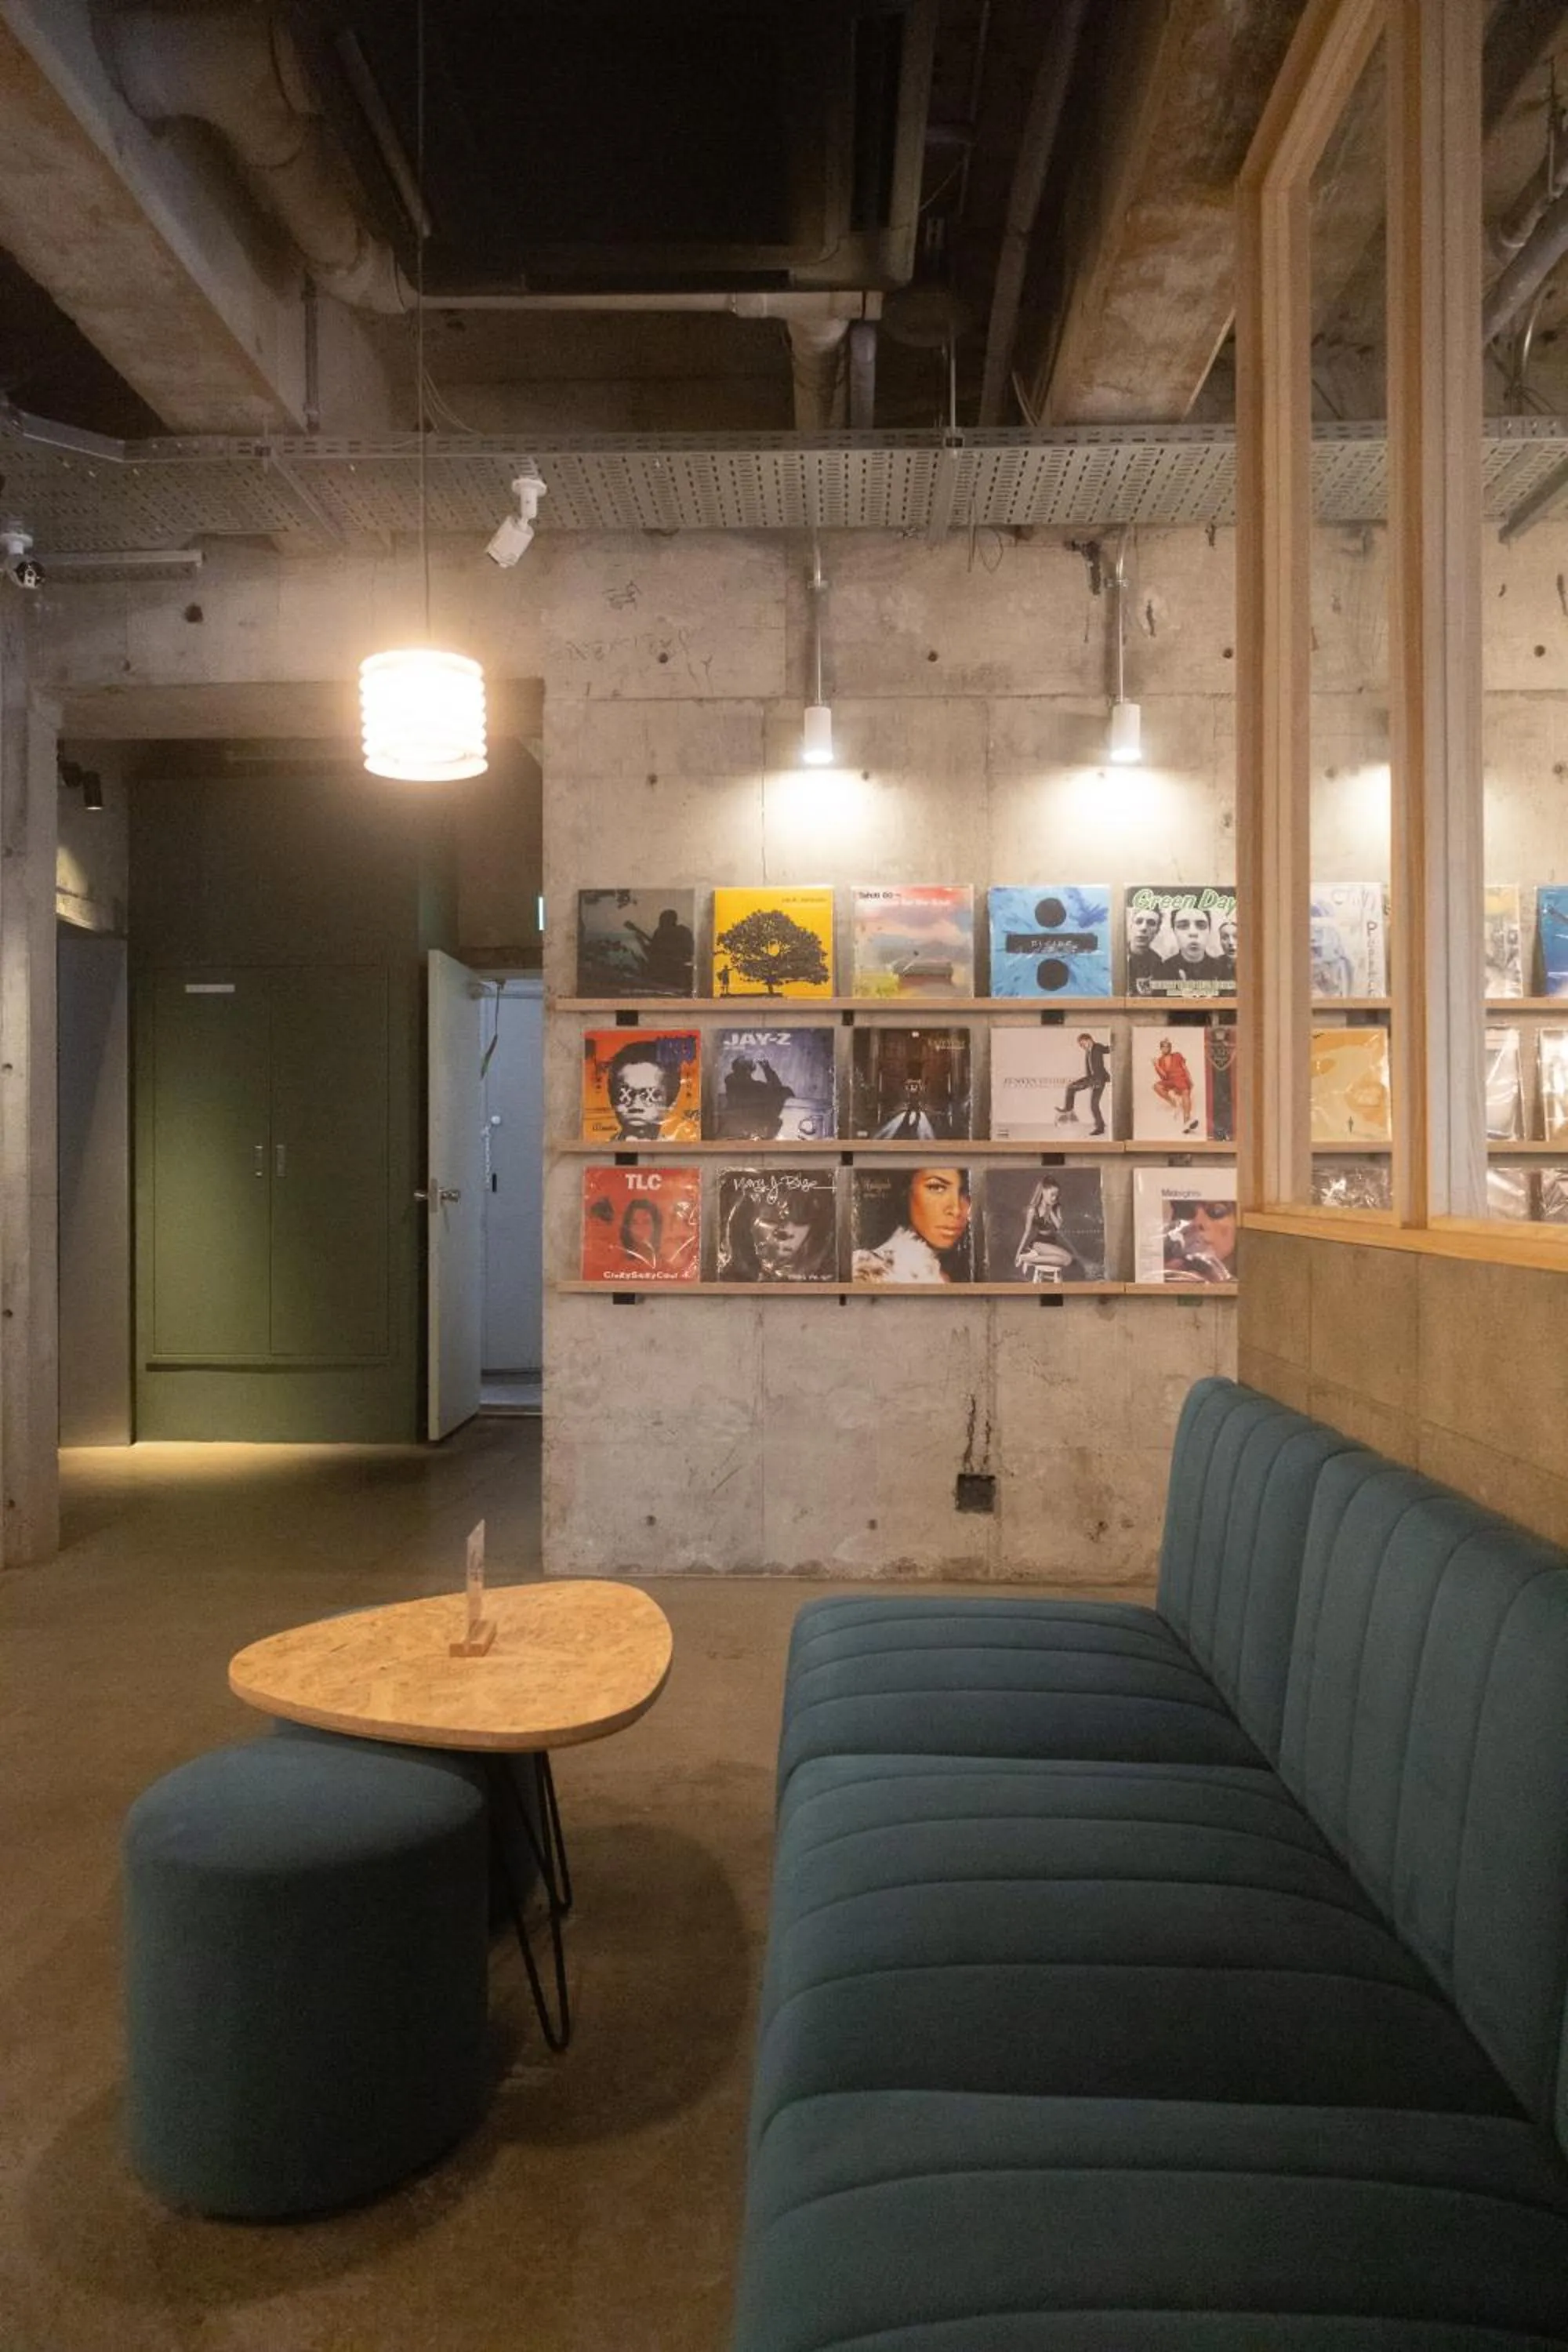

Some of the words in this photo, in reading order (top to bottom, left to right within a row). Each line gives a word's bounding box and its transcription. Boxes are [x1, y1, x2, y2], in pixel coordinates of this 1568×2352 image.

[1132, 888, 1197, 911] Green
[1197, 888, 1236, 922] Day
[723, 1033, 791, 1045] JAY-Z
[625, 1174, 662, 1190] TLC
